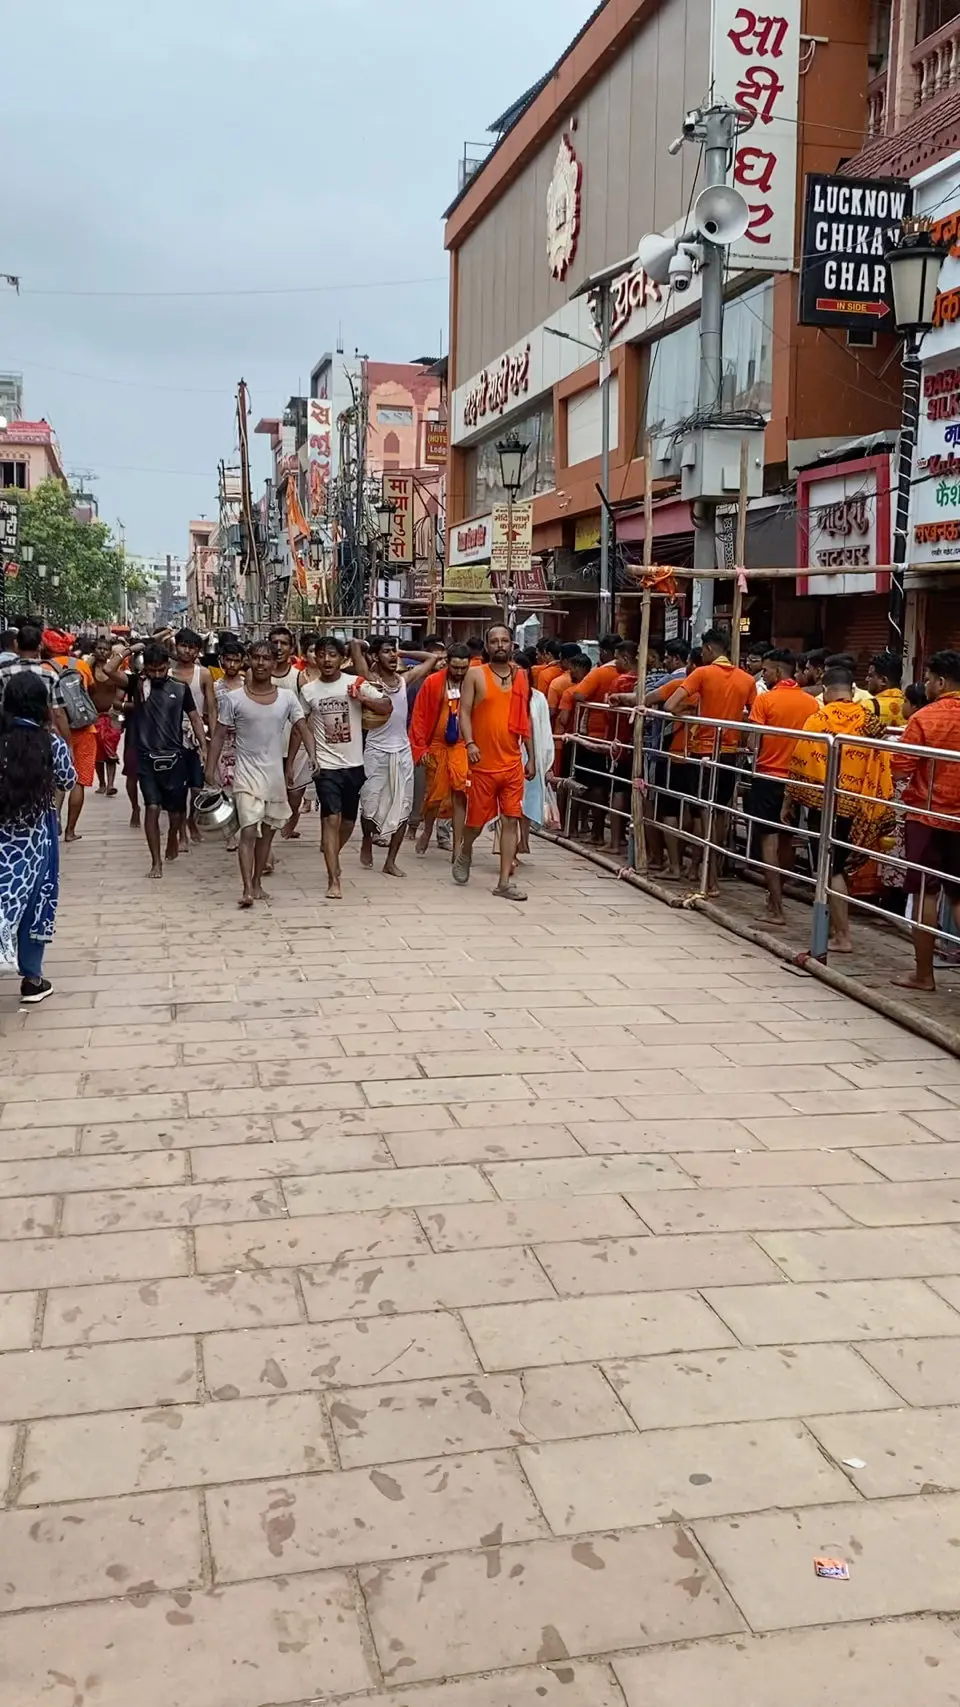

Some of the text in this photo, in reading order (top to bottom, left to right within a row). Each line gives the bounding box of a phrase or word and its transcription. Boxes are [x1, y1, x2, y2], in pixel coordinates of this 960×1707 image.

[813, 185, 906, 219] LUCKNOW
[824, 260, 886, 293] GHAR
[848, 304, 867, 312] SIDE
[430, 424, 447, 433] TRIP
[430, 445, 447, 455] Lodg
